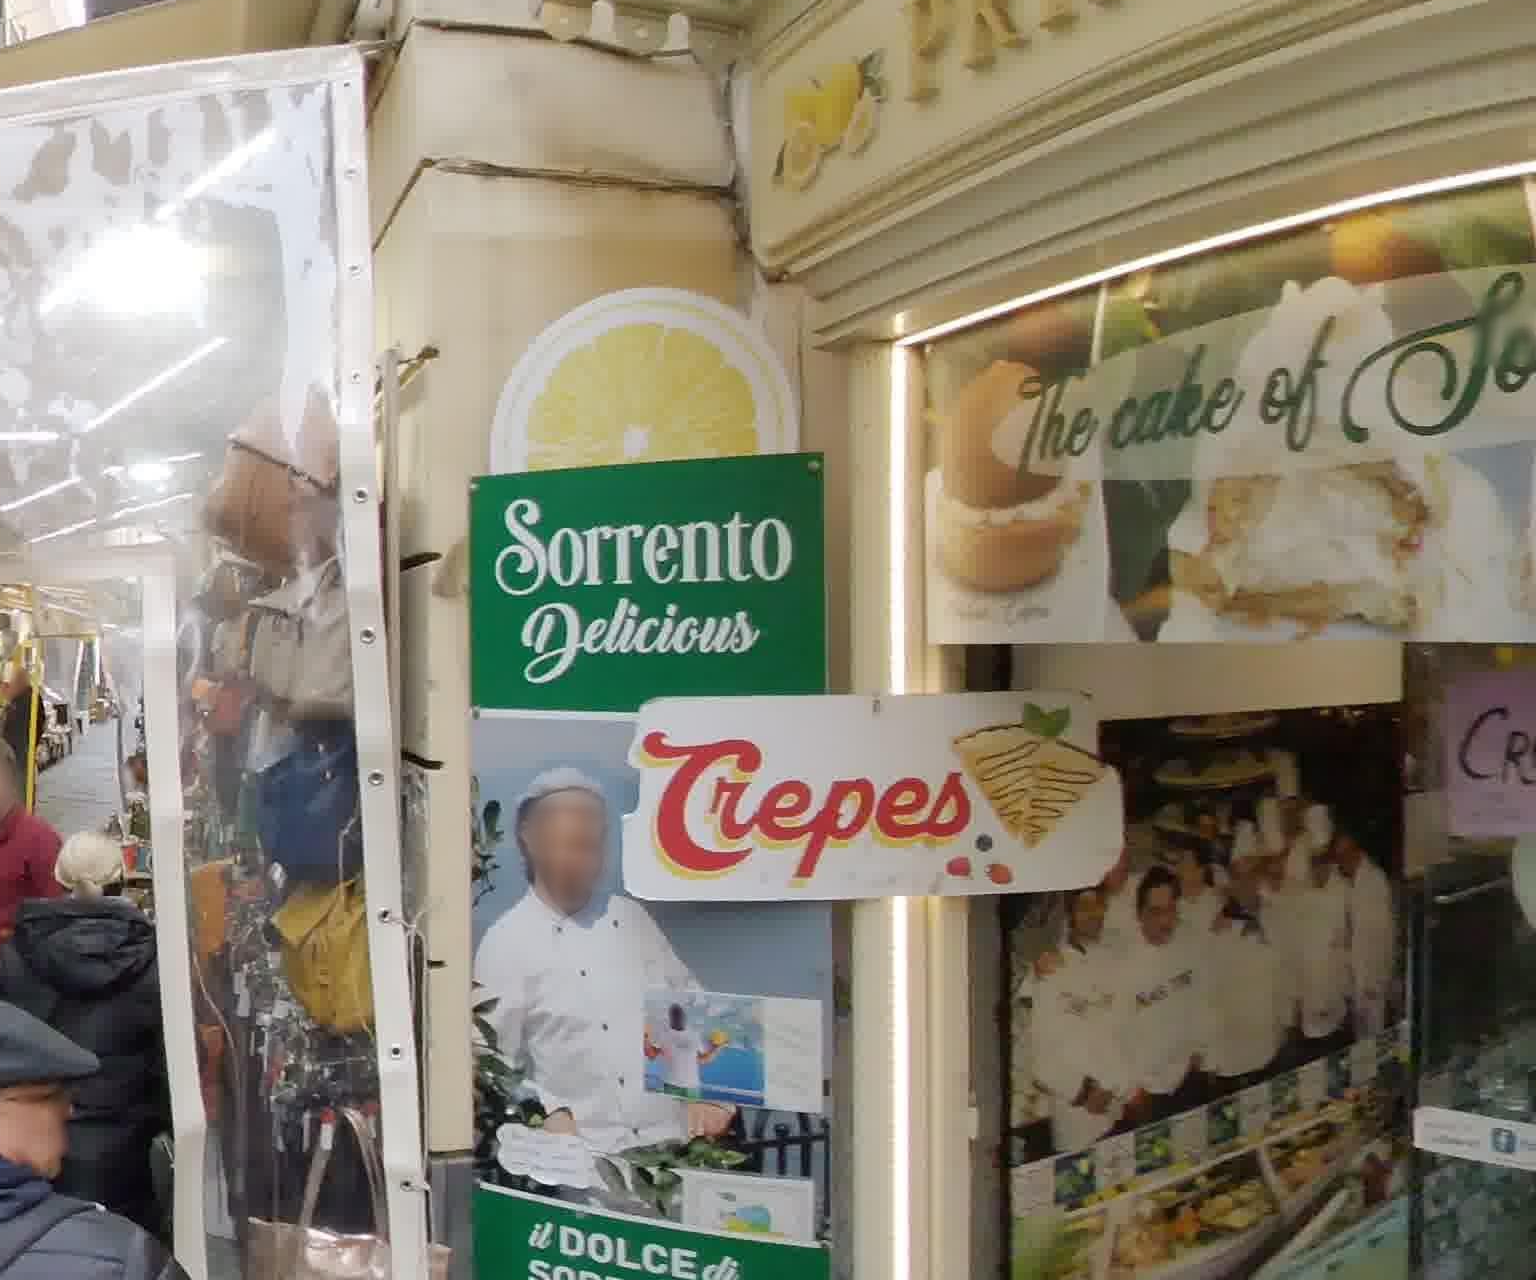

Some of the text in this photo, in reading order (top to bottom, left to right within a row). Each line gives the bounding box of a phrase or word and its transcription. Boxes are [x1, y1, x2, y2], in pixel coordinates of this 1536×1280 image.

[1017, 375, 1096, 475] The
[1102, 340, 1245, 450] cake
[1258, 314, 1338, 452] of
[495, 497, 793, 596] Sorrento
[520, 598, 760, 685] Delicious
[642, 730, 972, 888] Crepes
[527, 1221, 552, 1250] il
